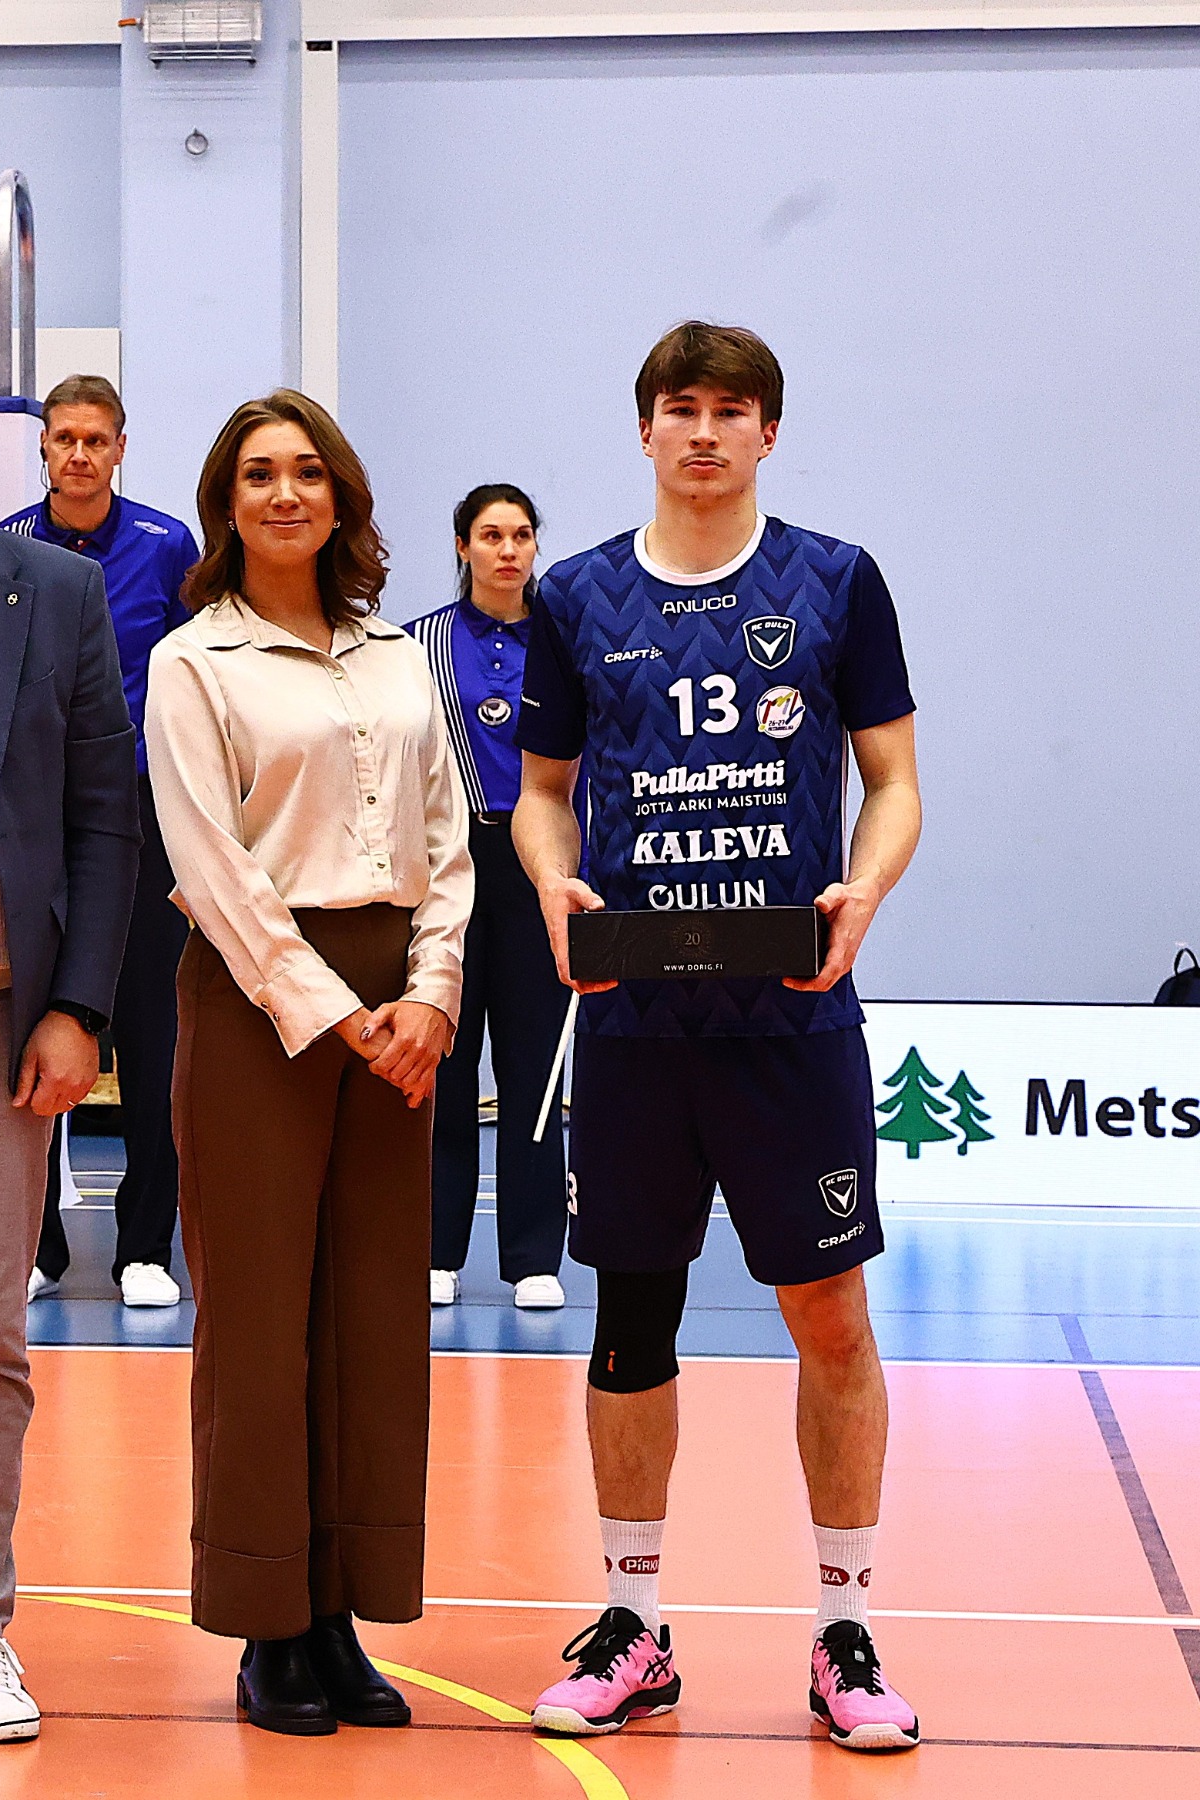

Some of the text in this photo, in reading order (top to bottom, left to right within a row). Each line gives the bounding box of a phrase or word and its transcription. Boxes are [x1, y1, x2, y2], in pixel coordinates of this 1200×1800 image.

[661, 594, 737, 615] ANUCO
[604, 649, 650, 664] CRAFT
[668, 674, 740, 737] 13
[631, 759, 785, 798] PullaPirtti
[635, 792, 787, 817] JOTTA ARKI MAISTUISI
[631, 824, 791, 864] KALEVA
[648, 879, 766, 910] OULUN
[684, 932, 701, 946] 20
[663, 963, 723, 972] WWW.DORIG.FI
[1025, 1078, 1200, 1139] Mets
[817, 1226, 859, 1249] CRAFT
